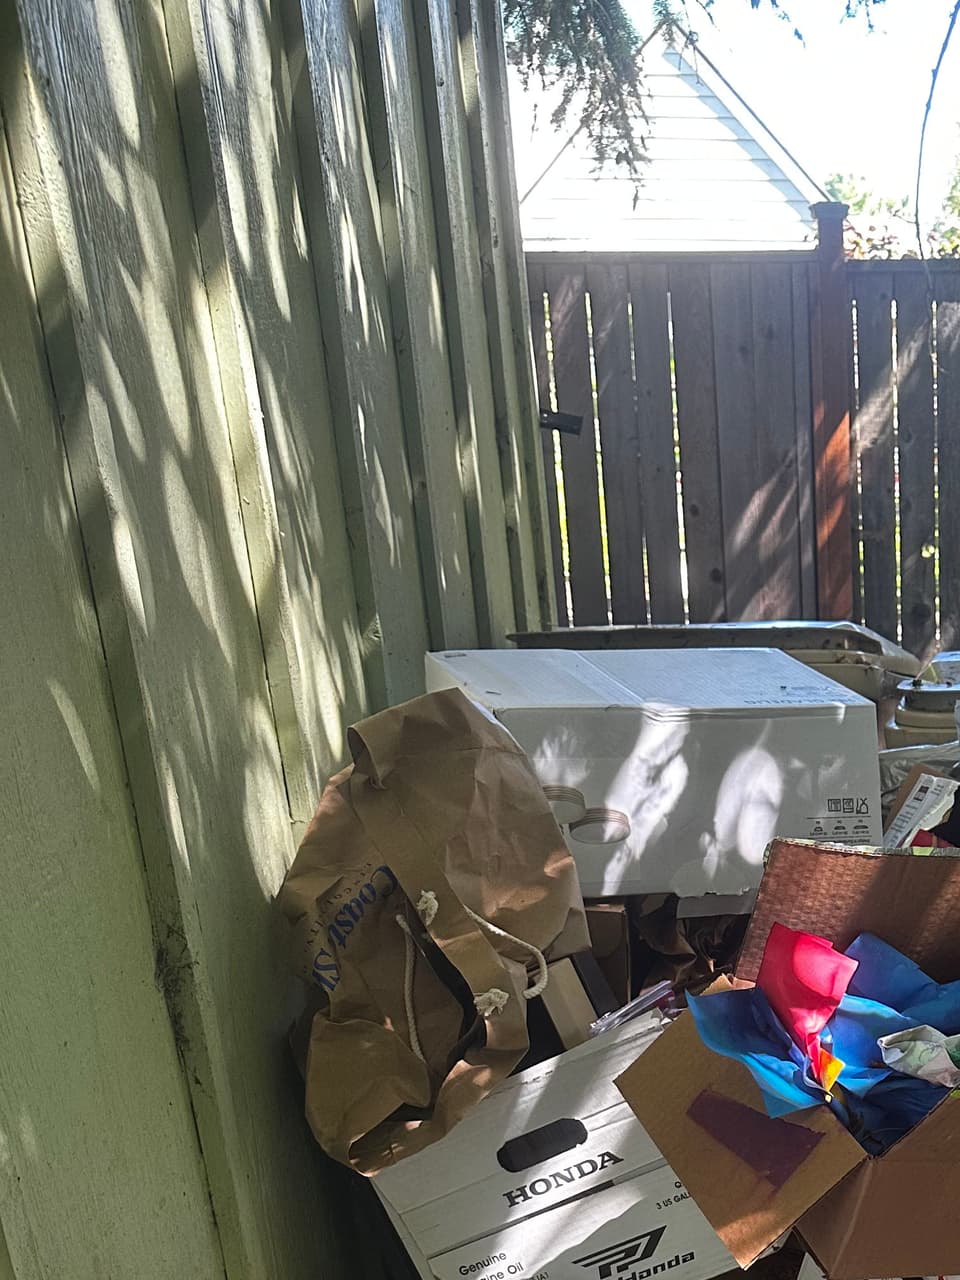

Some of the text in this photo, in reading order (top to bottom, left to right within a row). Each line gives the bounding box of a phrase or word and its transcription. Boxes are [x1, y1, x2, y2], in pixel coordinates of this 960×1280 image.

[502, 1151, 624, 1208] HONDA
[663, 1197, 673, 1207] US
[458, 1252, 507, 1277] Genuine
[507, 1262, 524, 1276] Oil
